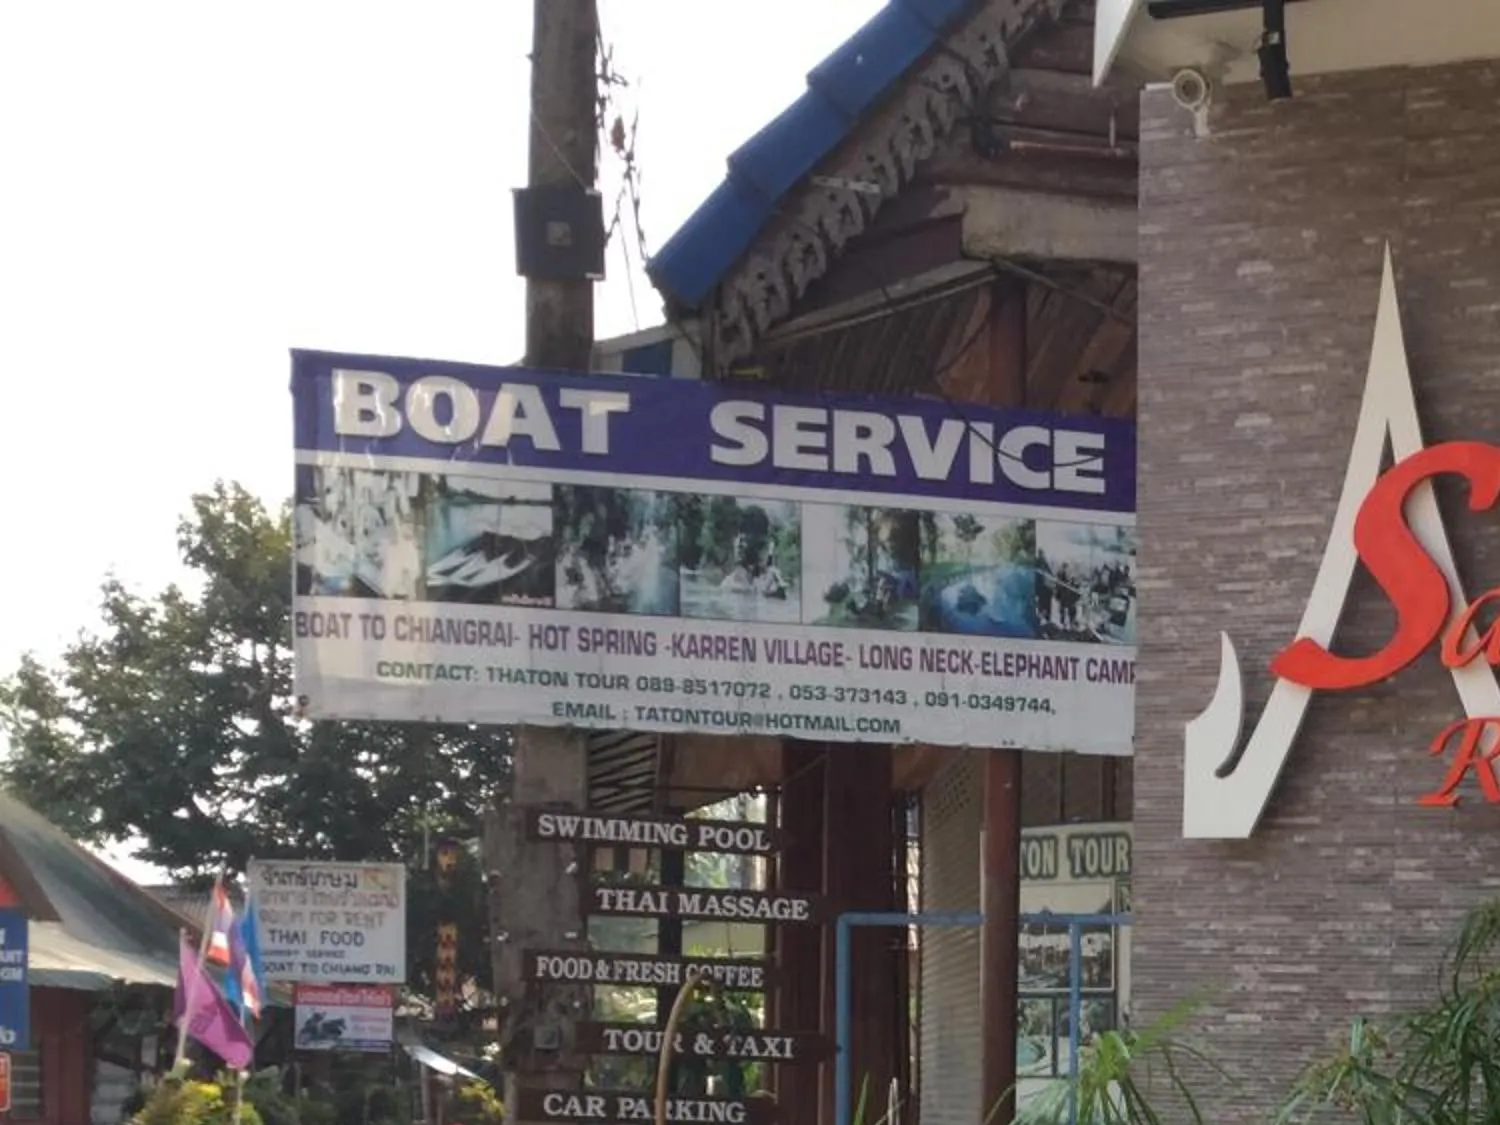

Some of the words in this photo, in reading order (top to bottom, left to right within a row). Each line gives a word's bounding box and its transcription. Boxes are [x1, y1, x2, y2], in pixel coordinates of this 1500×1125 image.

[332, 368, 631, 455] BOAT
[709, 400, 1106, 494] SERVICE
[296, 611, 353, 640] BOAT
[360, 613, 387, 641] TO
[529, 625, 570, 653] HOT
[577, 628, 657, 658] SPRING
[858, 644, 914, 672] LONG
[376, 660, 478, 684] CONTACT:
[486, 666, 569, 688] THATON
[573, 671, 630, 691] TOUR
[552, 701, 616, 721] EMAIL
[538, 814, 689, 845] SWIMMING
[698, 826, 771, 851] POOL
[1070, 834, 1130, 875] TOUR
[596, 888, 668, 914] THAI
[678, 893, 810, 921] MASSAGE
[268, 929, 307, 945] THAI
[320, 930, 365, 947] FOOD
[694, 1032, 715, 1056] &
[723, 1034, 795, 1059] TAXI
[543, 1093, 607, 1118] CAR
